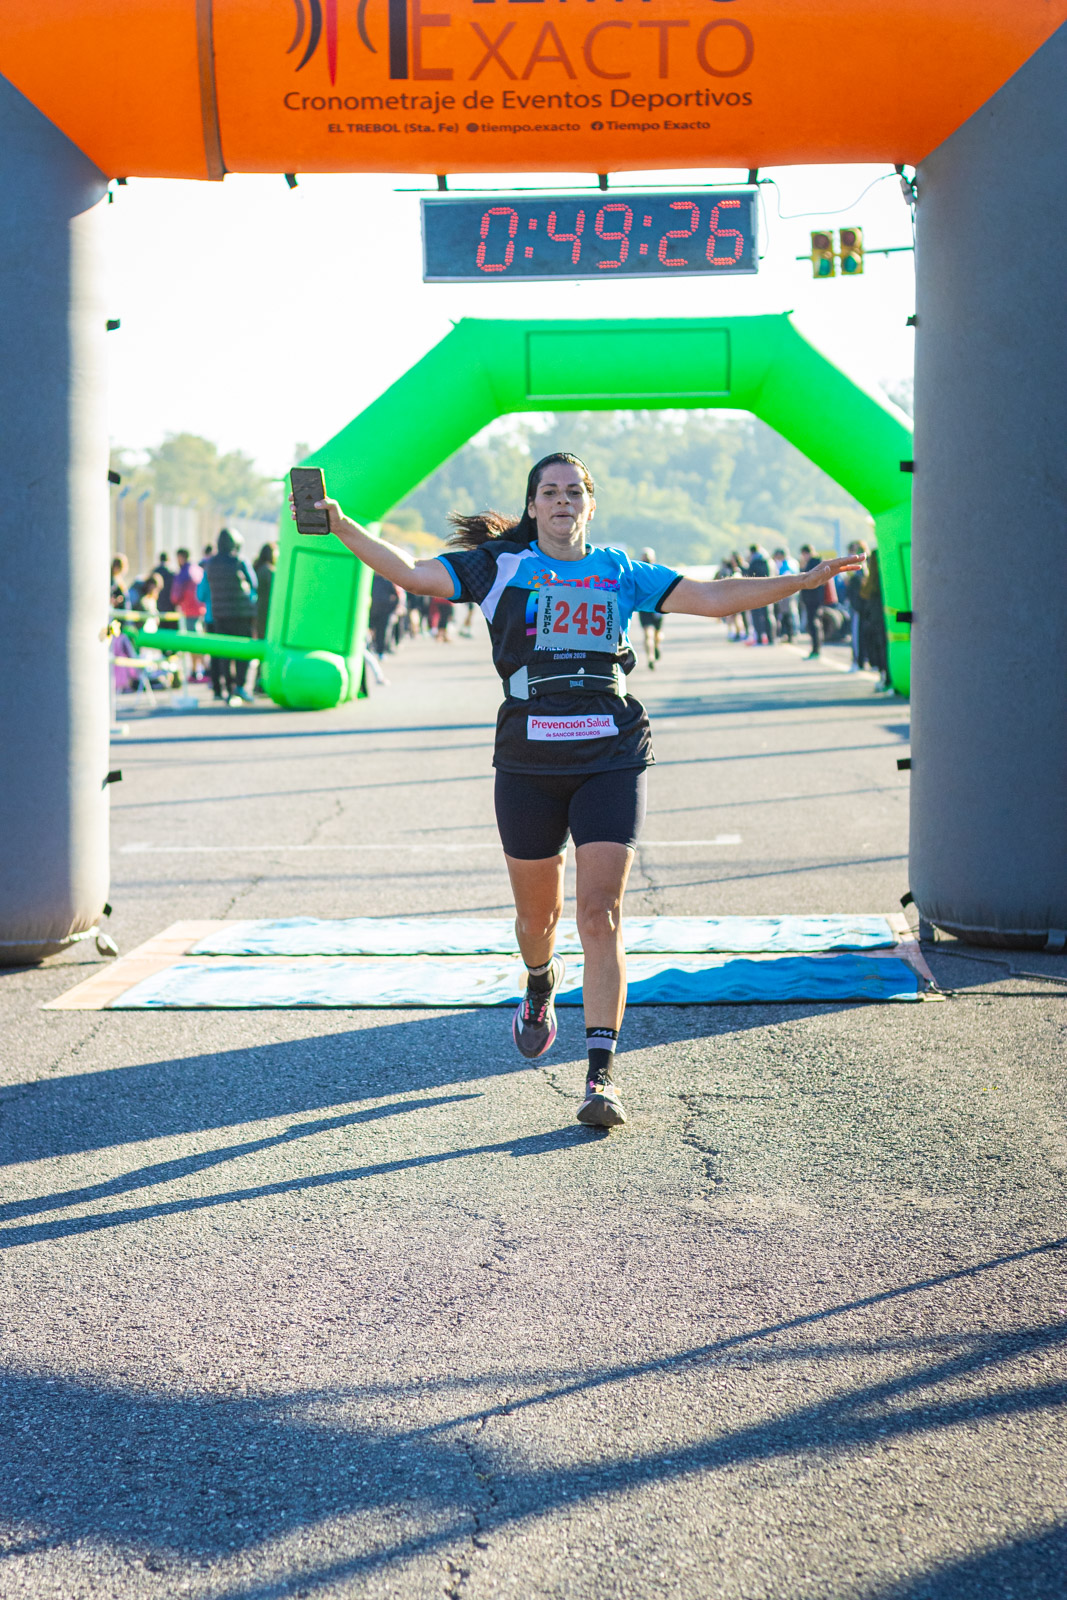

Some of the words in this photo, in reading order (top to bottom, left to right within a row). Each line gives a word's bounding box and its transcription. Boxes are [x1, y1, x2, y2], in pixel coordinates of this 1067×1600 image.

[412, 0, 755, 80] EXACTO
[283, 91, 456, 114] Cronometraje
[463, 90, 494, 110] de
[502, 90, 602, 109] Eventos
[610, 88, 753, 111] Deportivos
[327, 122, 344, 133] EL
[346, 122, 401, 133] TREBOL
[403, 122, 435, 134] (Sta.
[438, 122, 459, 133] Fe)
[605, 120, 660, 132] Tiempo
[663, 120, 711, 131] Exacto
[476, 199, 745, 272] 0:49:26
[542, 595, 553, 635] TIEMPO
[552, 600, 607, 637] 245
[605, 601, 614, 641] EXACTO
[531, 718, 586, 729] Prevención
[586, 717, 611, 728] Salud
